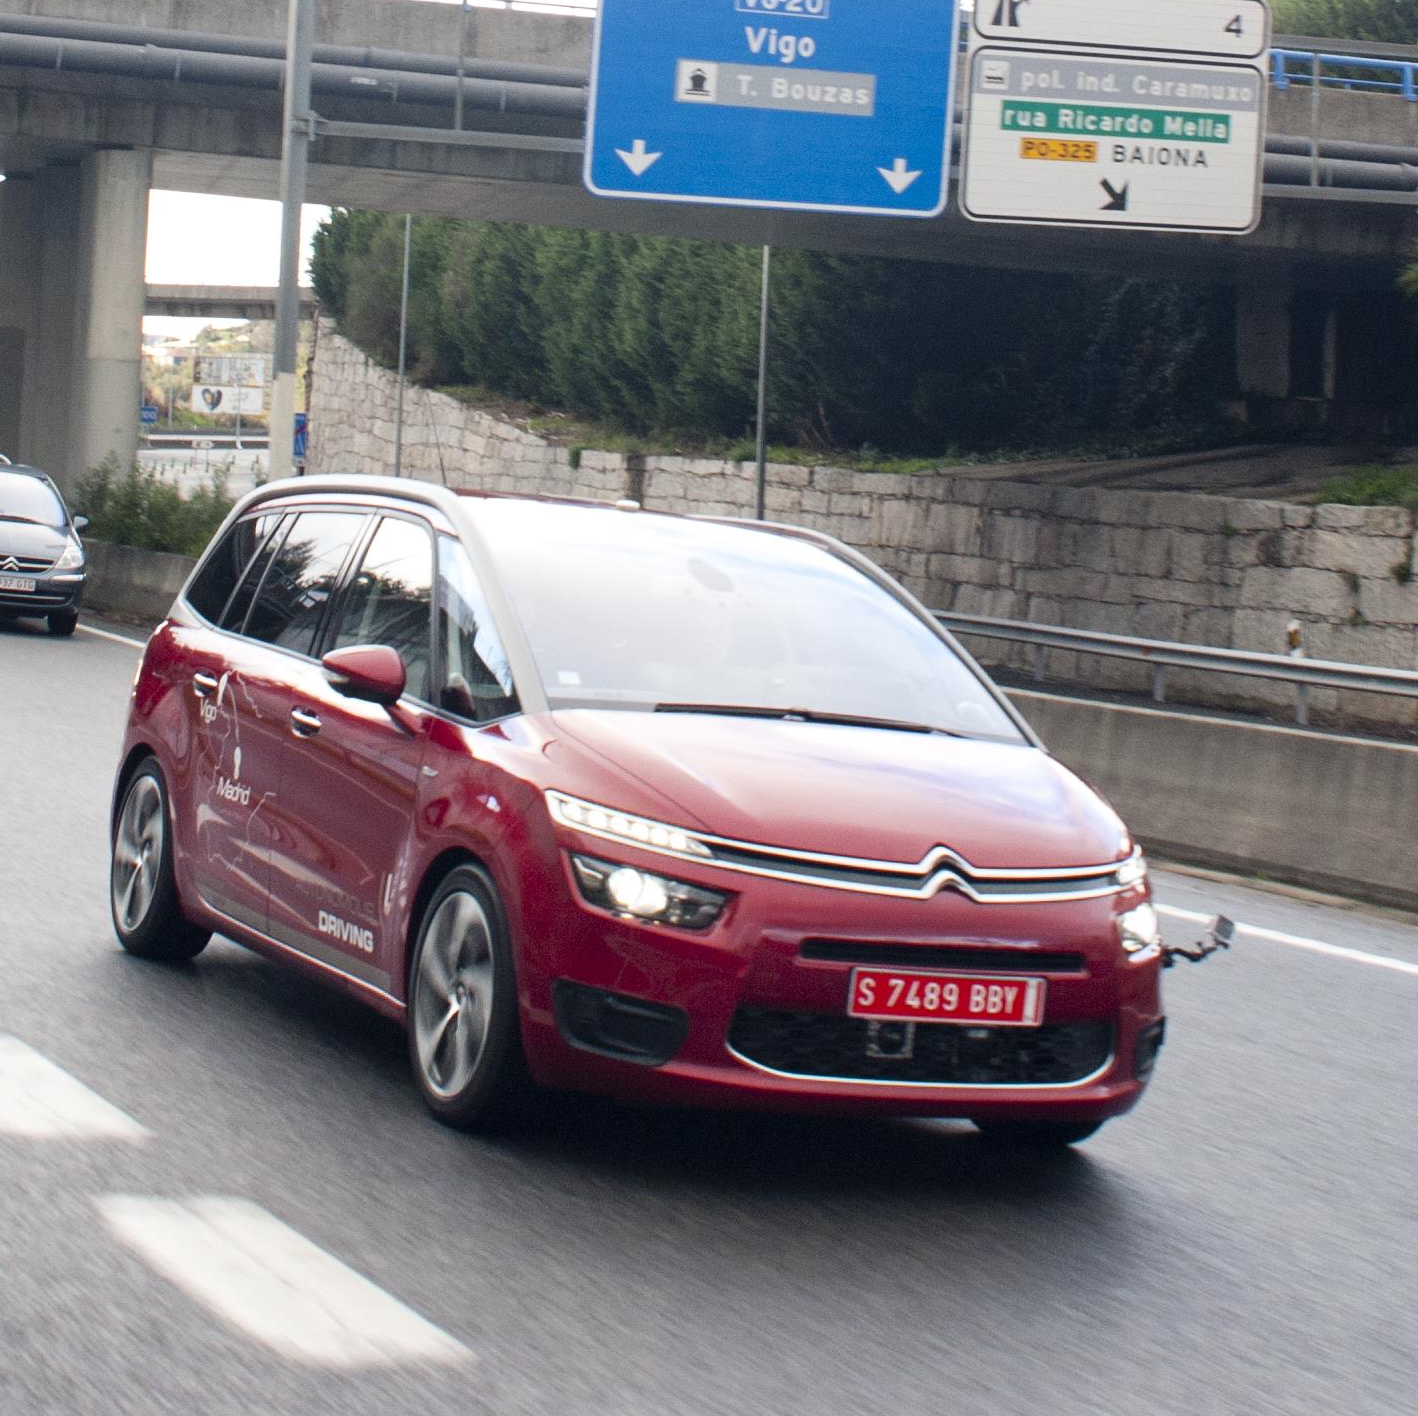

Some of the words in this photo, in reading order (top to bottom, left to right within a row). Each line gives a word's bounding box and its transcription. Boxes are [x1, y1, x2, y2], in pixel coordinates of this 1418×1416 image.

[1225, 15, 1242, 38] 4
[744, 26, 816, 64] Vigo
[737, 74, 759, 97] T.
[771, 78, 870, 106] Bouzas
[1021, 70, 1064, 92] pol.
[1077, 72, 1121, 93] ind.
[1133, 75, 1254, 102] Caramuxo
[1003, 108, 1047, 128] rua
[1058, 109, 1154, 134] Ricardo
[1163, 116, 1229, 139] Mella
[1023, 140, 1096, 161] PO-325
[1113, 145, 1209, 168] BAIONA
[200, 698, 218, 723] Vigo
[217, 776, 251, 806] Madrid
[318, 909, 374, 954] DRIVING
[857, 977, 877, 1007] S
[886, 978, 959, 1012] 7489
[968, 983, 1019, 1014] BBY
